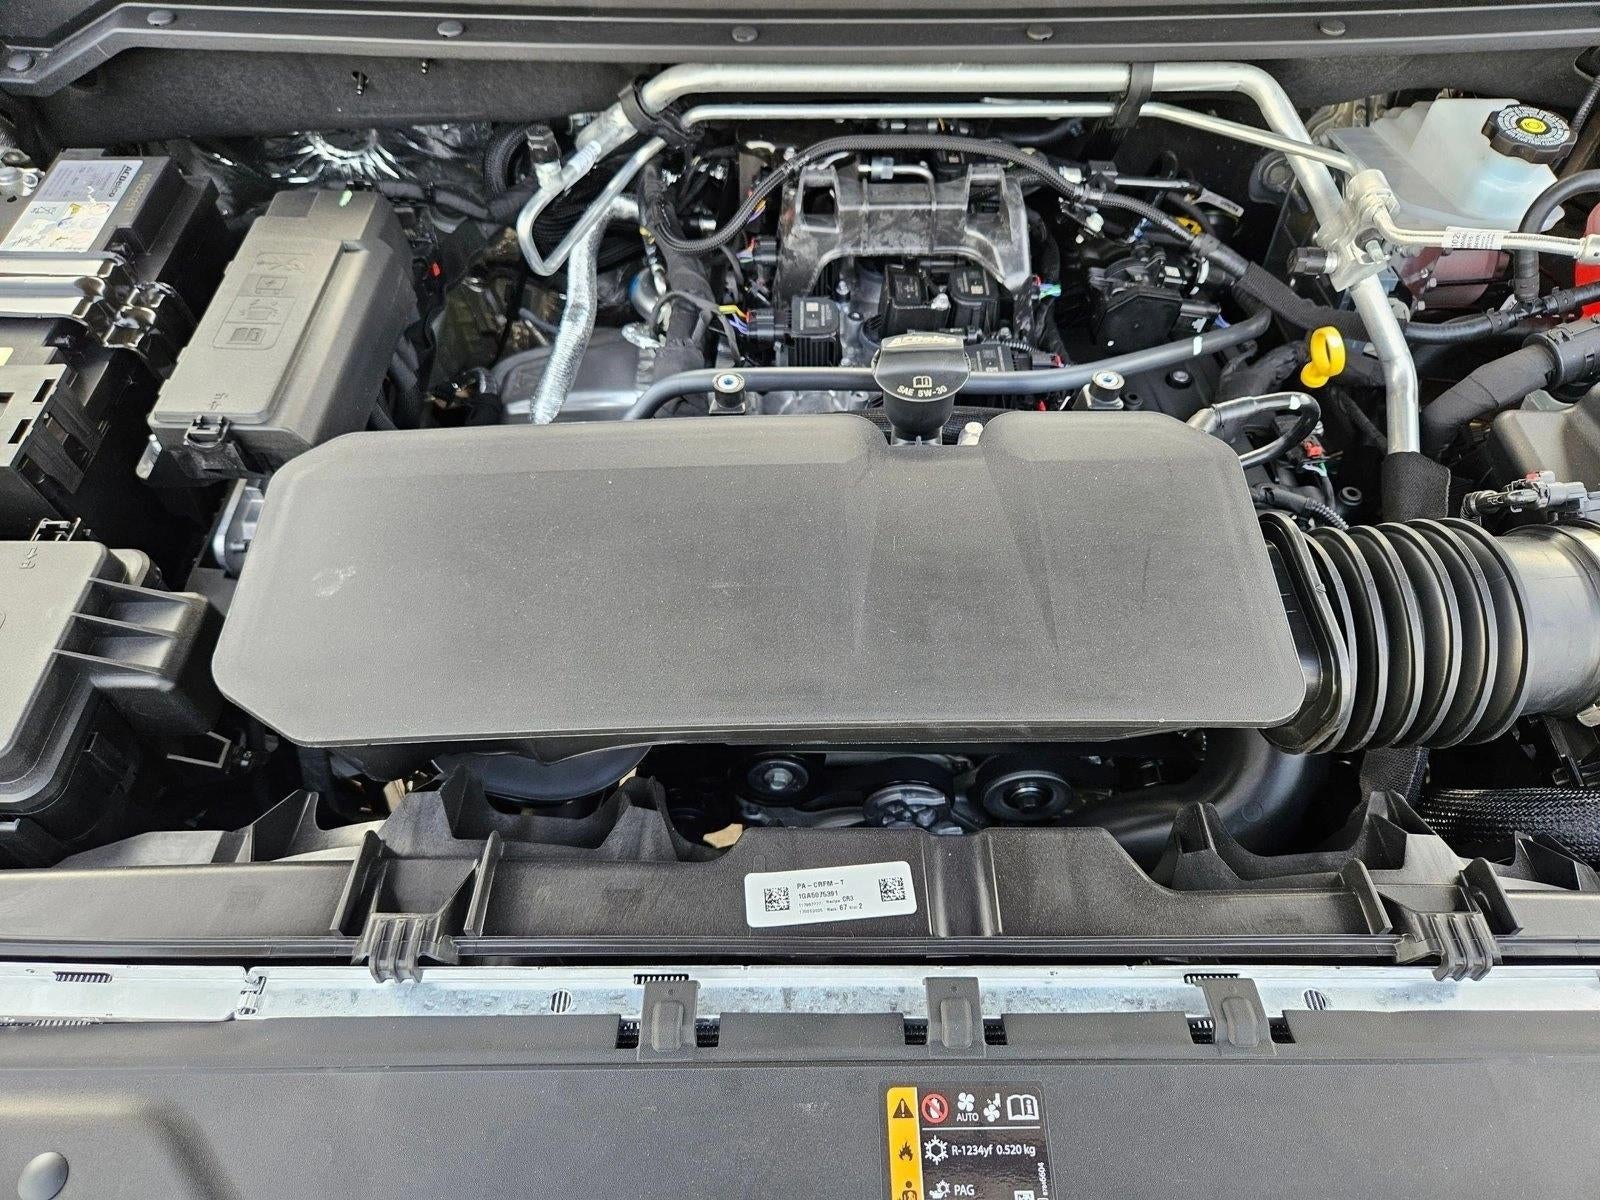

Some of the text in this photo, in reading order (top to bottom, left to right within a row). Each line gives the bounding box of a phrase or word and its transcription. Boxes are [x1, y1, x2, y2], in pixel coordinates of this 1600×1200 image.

[887, 335, 957, 347] ACDelco
[896, 385, 948, 398] SAE 5W-30
[858, 902, 863, 910] 2
[956, 1112, 979, 1122] AUTO
[951, 1143, 1036, 1158] R-1234yf 0.520 kg
[954, 1184, 975, 1197] PAG
